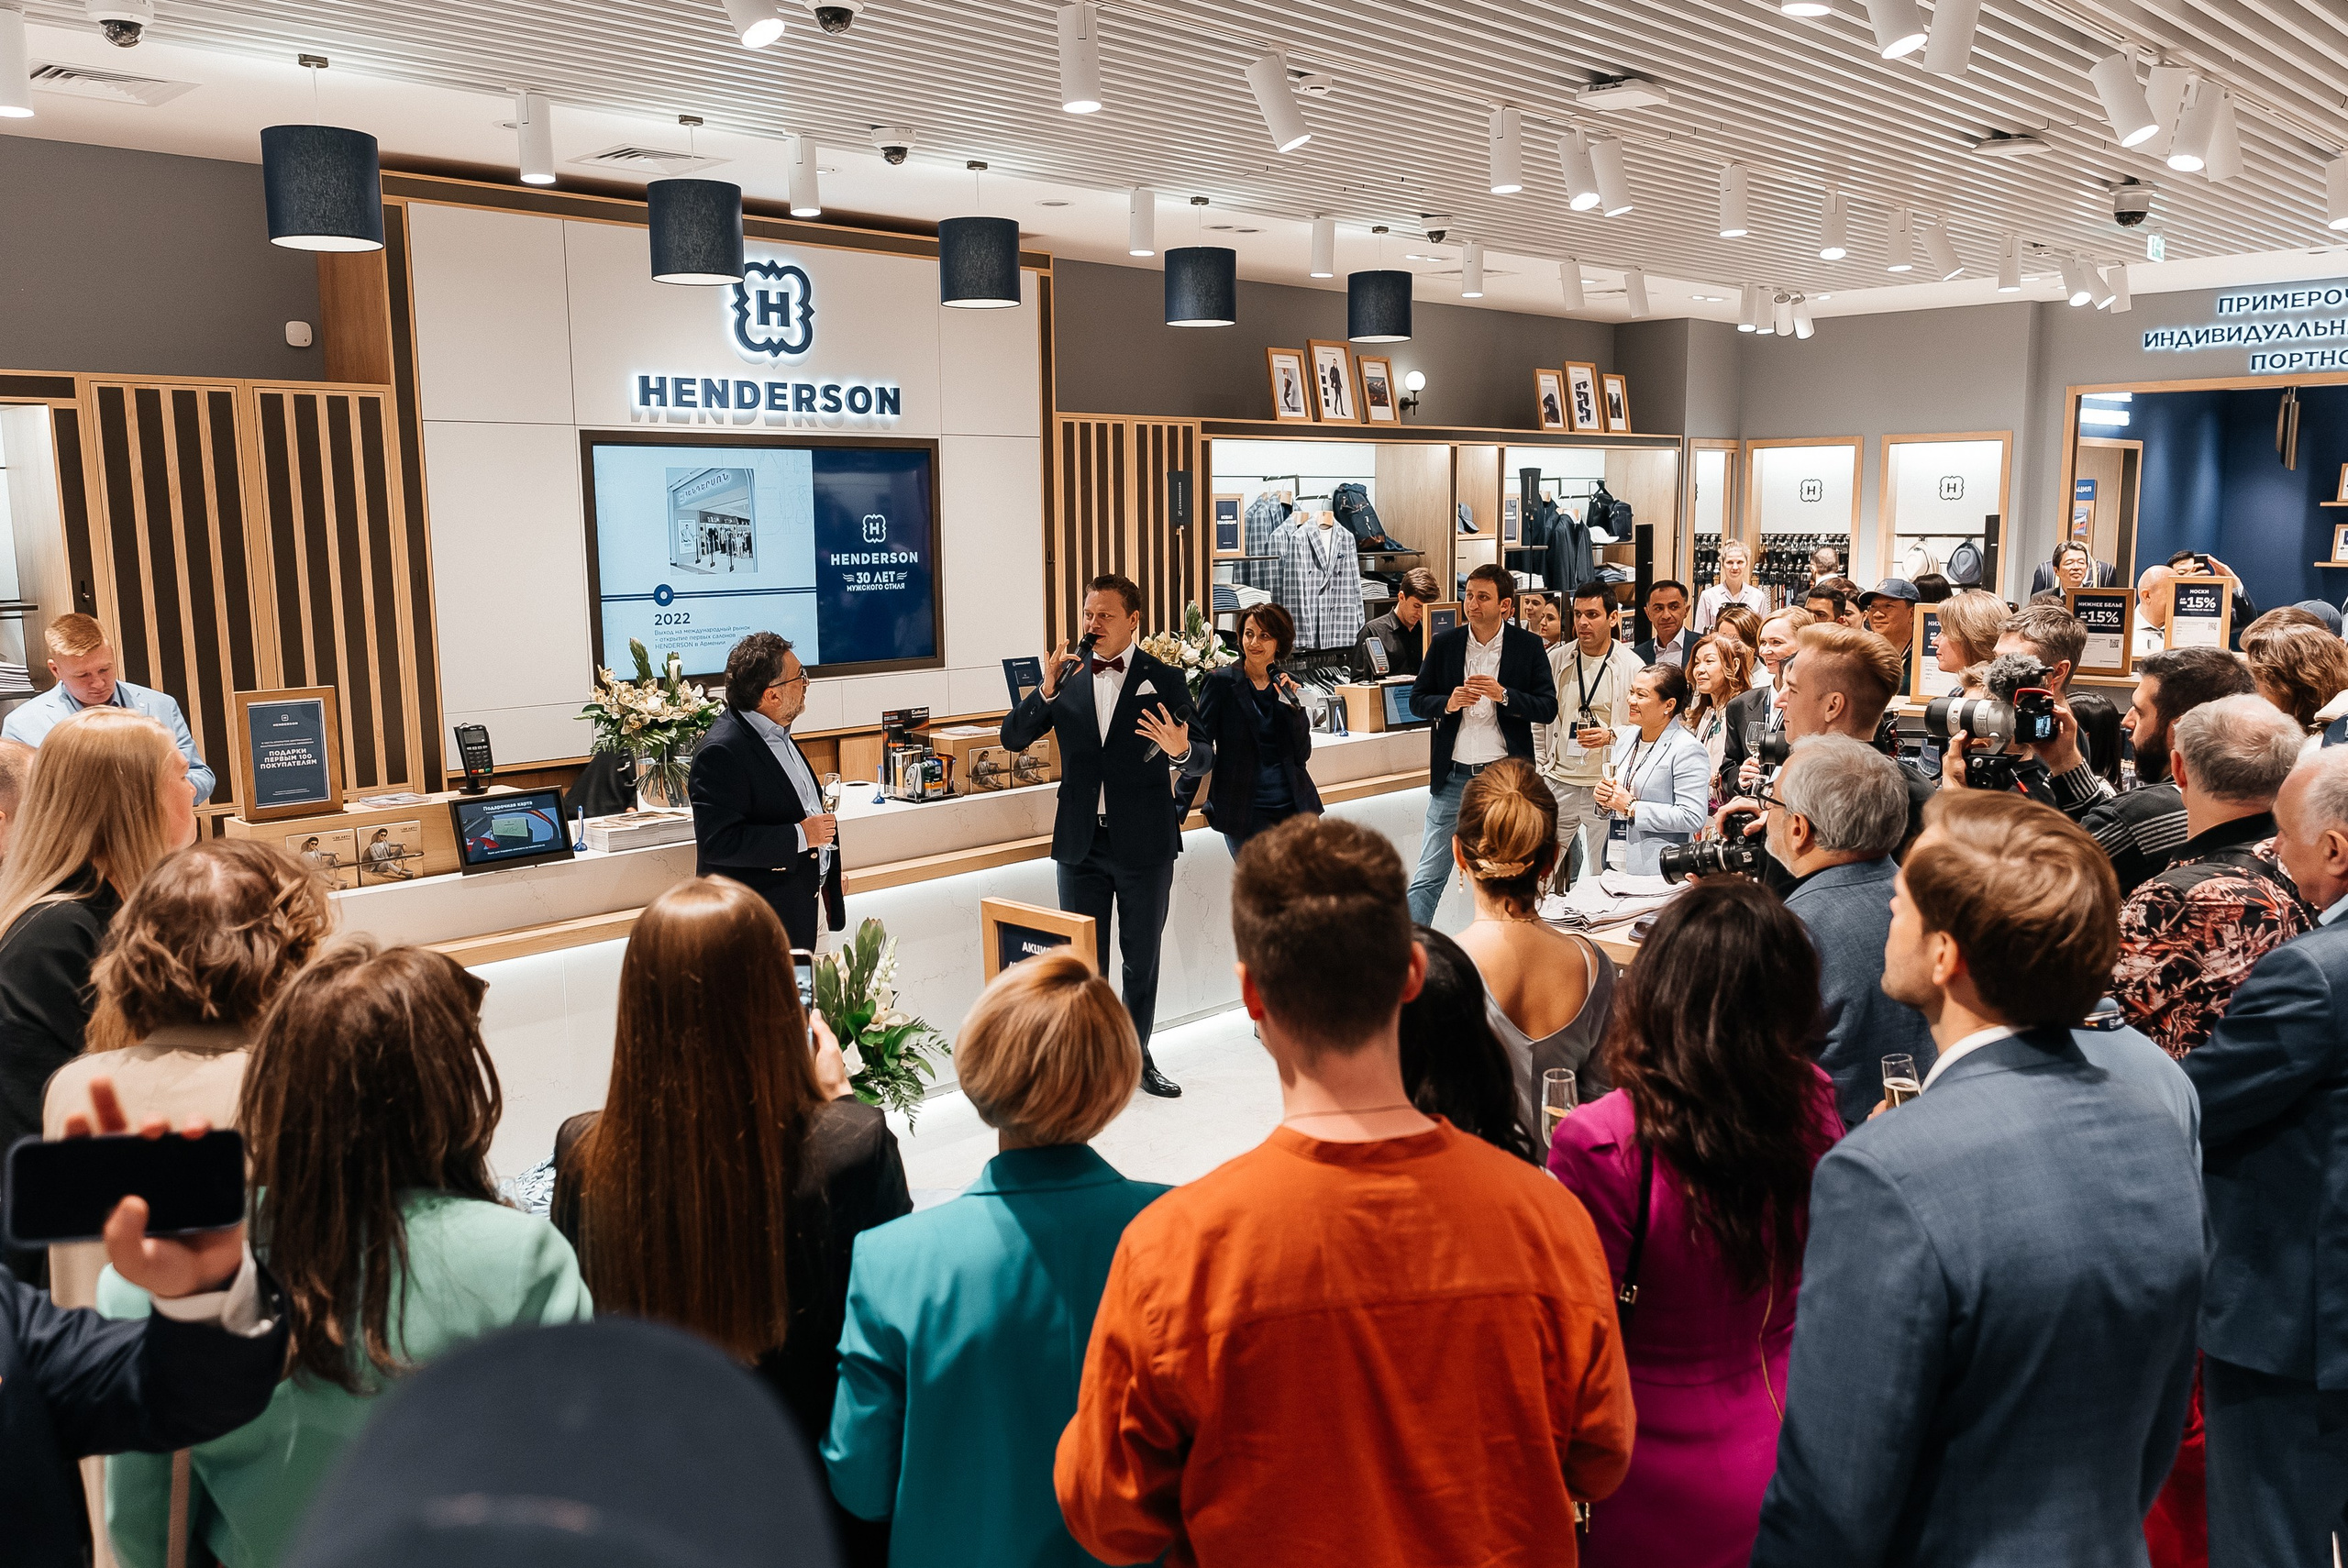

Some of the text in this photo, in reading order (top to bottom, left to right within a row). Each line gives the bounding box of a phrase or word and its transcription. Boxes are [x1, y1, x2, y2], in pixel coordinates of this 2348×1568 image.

[2218, 288, 2348, 314] ПРИМЕРО
[756, 290, 791, 327] H
[2144, 319, 2348, 348] ИНДИВИДУАЛЬН
[638, 376, 901, 415] HENDERSON
[1807, 486, 1816, 495] H
[1946, 482, 1956, 493] H
[869, 523, 880, 536] H
[831, 552, 918, 566] HENDERSON
[857, 570, 895, 583] 30 ЛЕТ
[847, 582, 905, 592] МУЖСКОГО СТИЛЯ
[654, 613, 691, 625] 2022
[2080, 611, 2119, 624] -15%
[269, 748, 306, 756] ПОДАРКИ
[260, 759, 317, 769] ПОКУПАТЕЛЯМ
